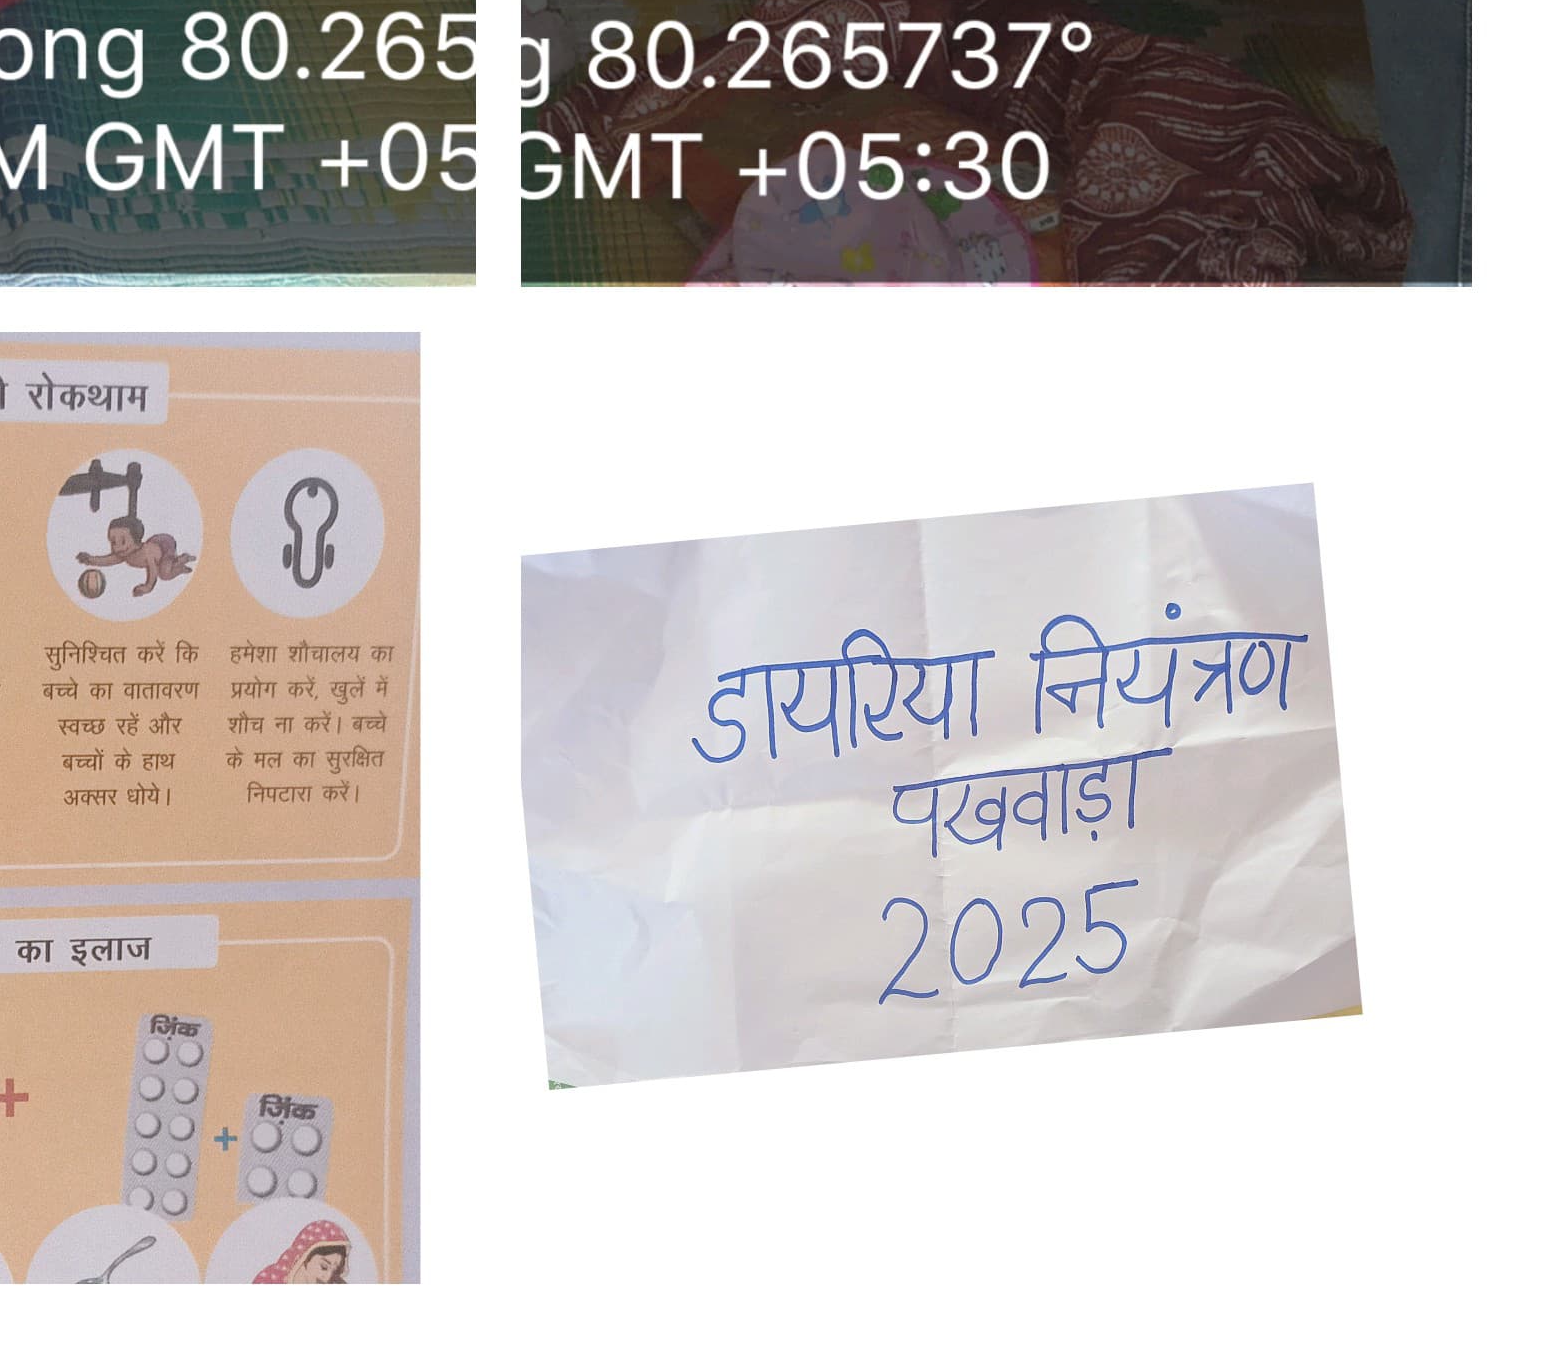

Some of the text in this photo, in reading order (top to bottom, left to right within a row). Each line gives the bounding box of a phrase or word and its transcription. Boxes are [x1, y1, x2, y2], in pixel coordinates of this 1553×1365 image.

[25, 371, 149, 412] रोकथाम
[230, 640, 395, 664] हमेशा शौचालय का
[231, 675, 388, 704] प्रयोग करें, खुलें में
[693, 602, 1308, 763] डायरिया नियंत्रण
[227, 711, 264, 734] शौच
[275, 717, 294, 733] ना
[352, 710, 387, 733] बच्चे
[226, 745, 384, 774] के मल का सुरक्षित
[247, 781, 312, 803] निपटारा
[893, 747, 1173, 858] पखवाड़ा
[15, 940, 52, 965] का
[70, 937, 152, 965] इलाज
[878, 878, 1138, 1005] 2025
